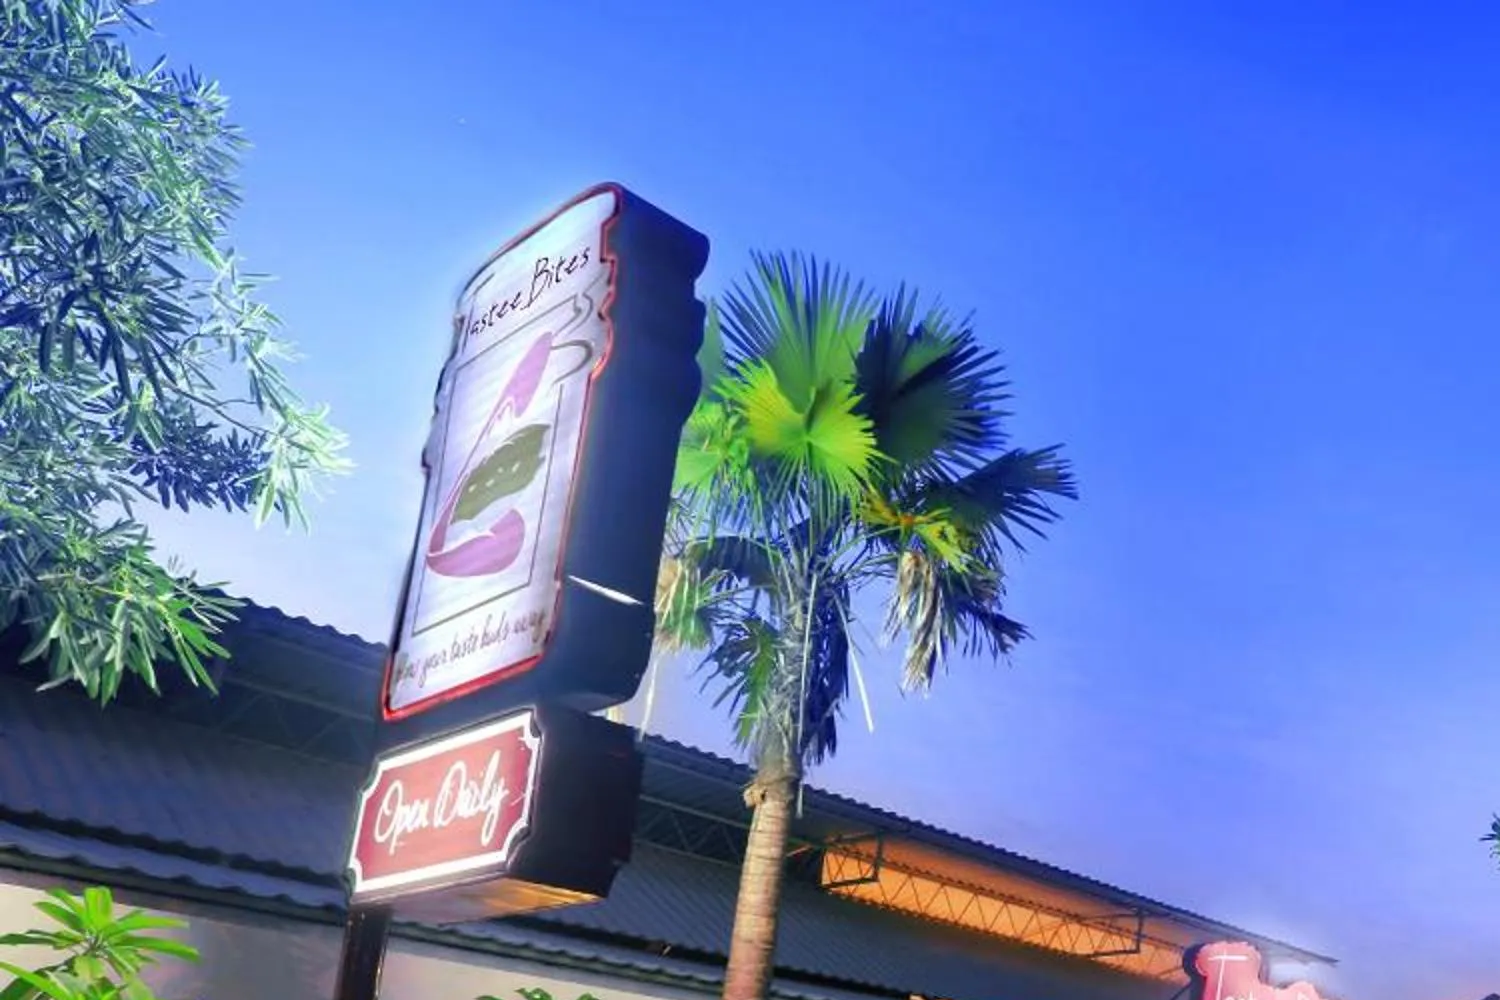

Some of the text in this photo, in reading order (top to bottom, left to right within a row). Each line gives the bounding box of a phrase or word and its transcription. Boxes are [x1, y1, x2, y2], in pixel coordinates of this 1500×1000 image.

[520, 247, 591, 311] Bites
[374, 749, 510, 856] Open Daily
